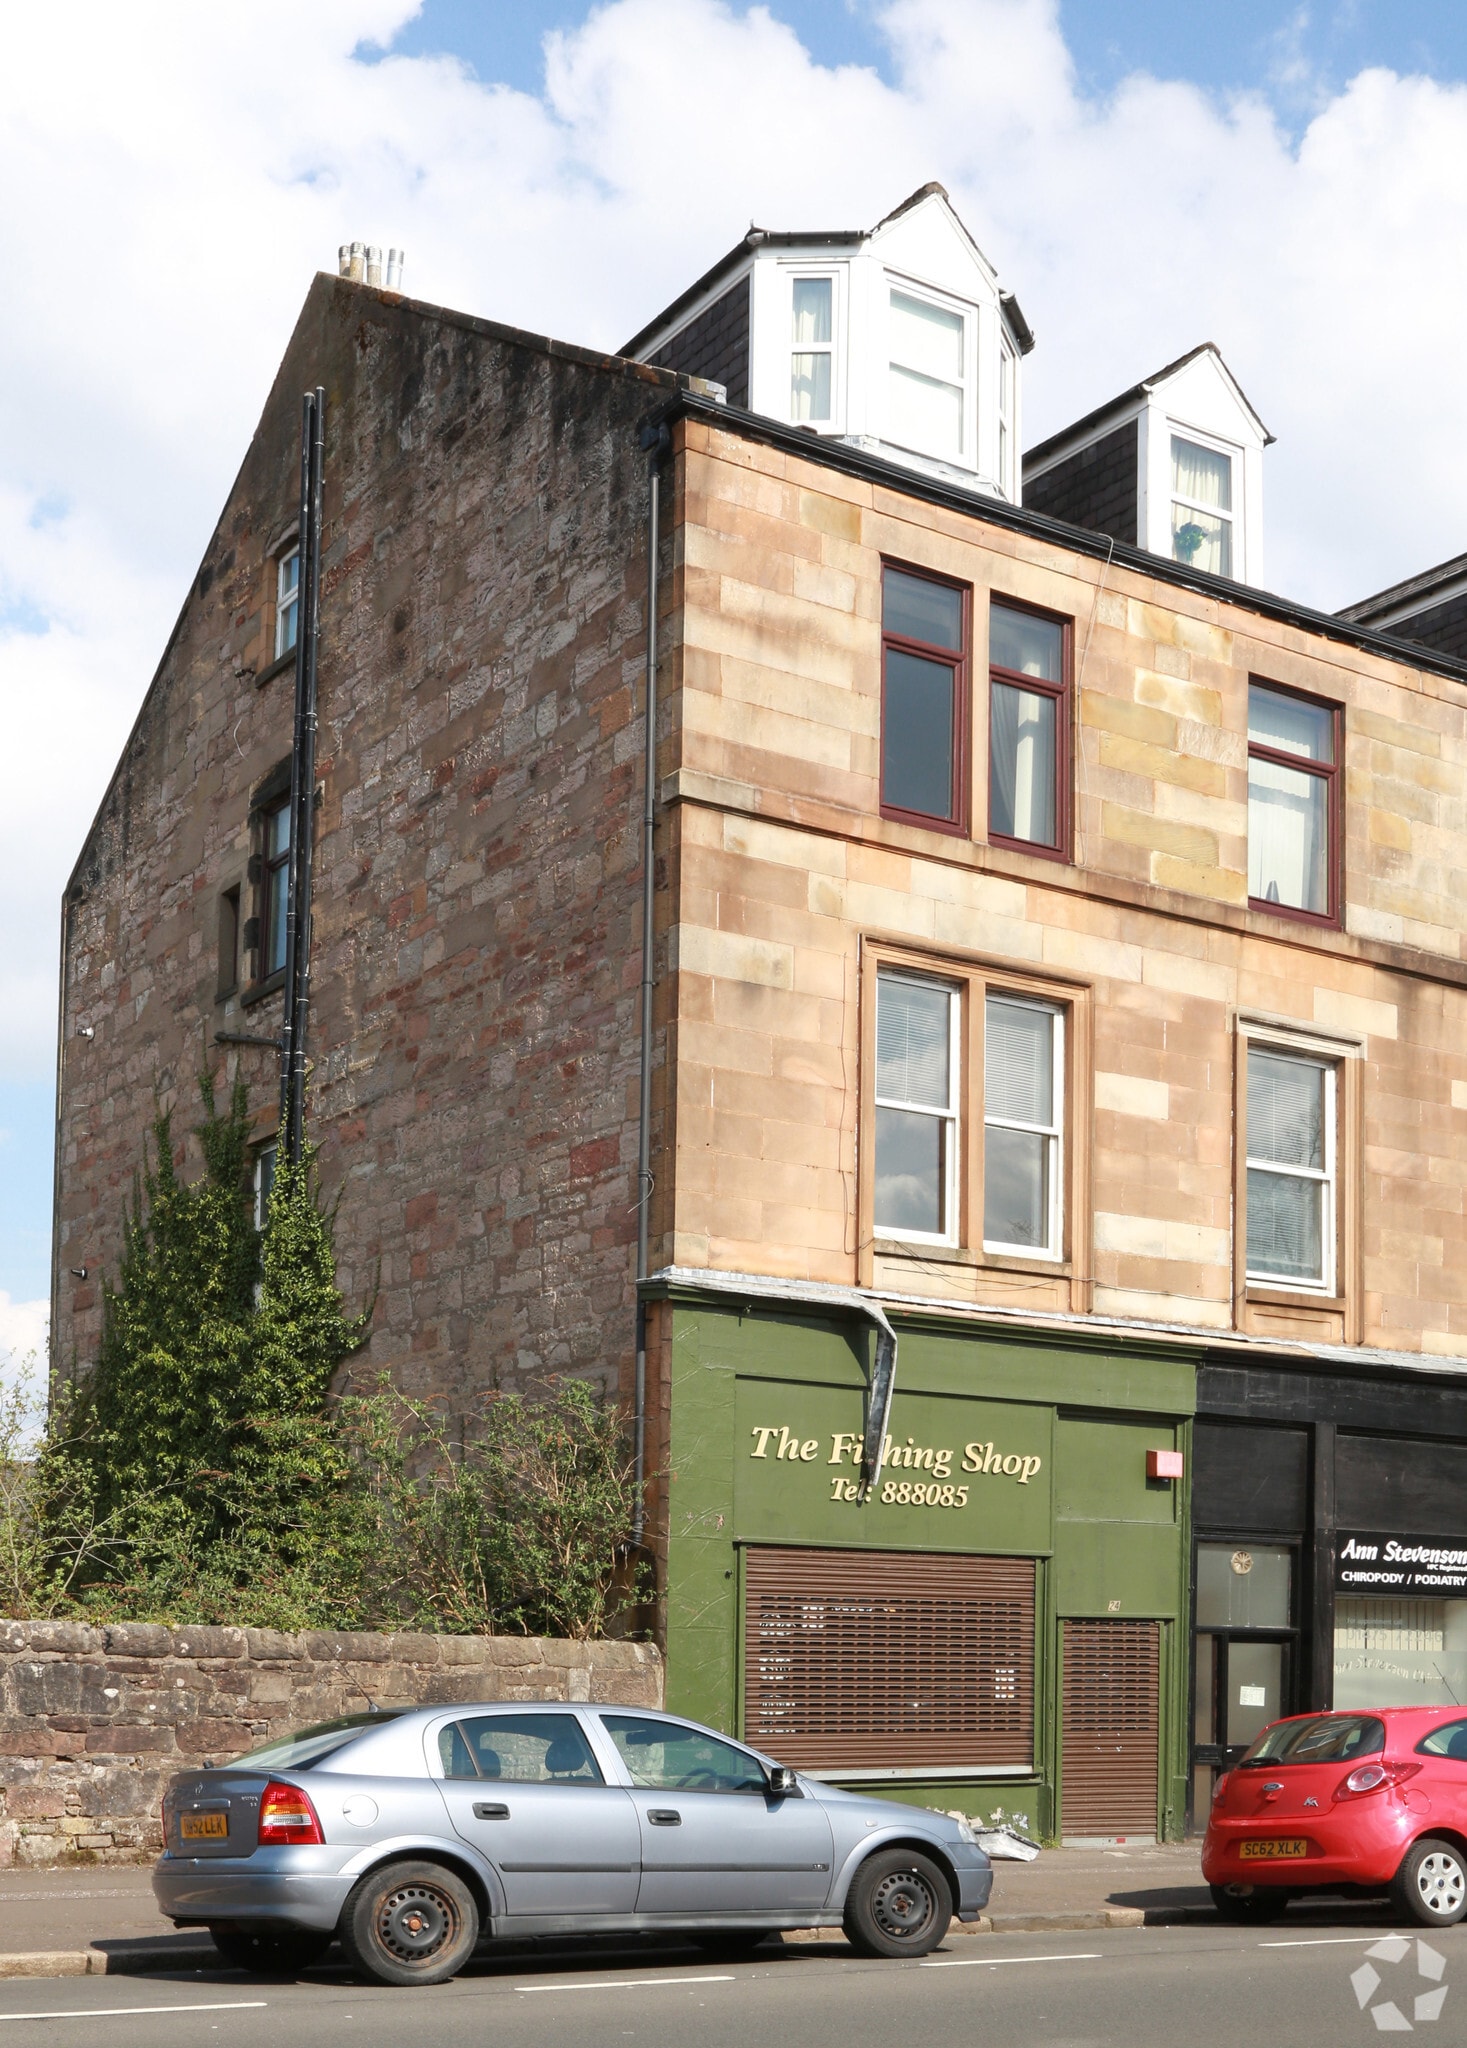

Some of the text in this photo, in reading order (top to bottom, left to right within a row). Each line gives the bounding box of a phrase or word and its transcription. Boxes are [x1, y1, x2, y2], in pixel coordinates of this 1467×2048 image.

[750, 1425, 1042, 1484] The Fihing Shop
[830, 1477, 969, 1508] Tel: 888085
[1341, 1539, 1379, 1561] Ann
[1341, 1571, 1404, 1584] CHIROPODY
[1415, 1574, 1467, 1586] PODIATRY
[1109, 1601, 1120, 1611] 24
[1244, 1841, 1302, 1856] SC62 XLK
